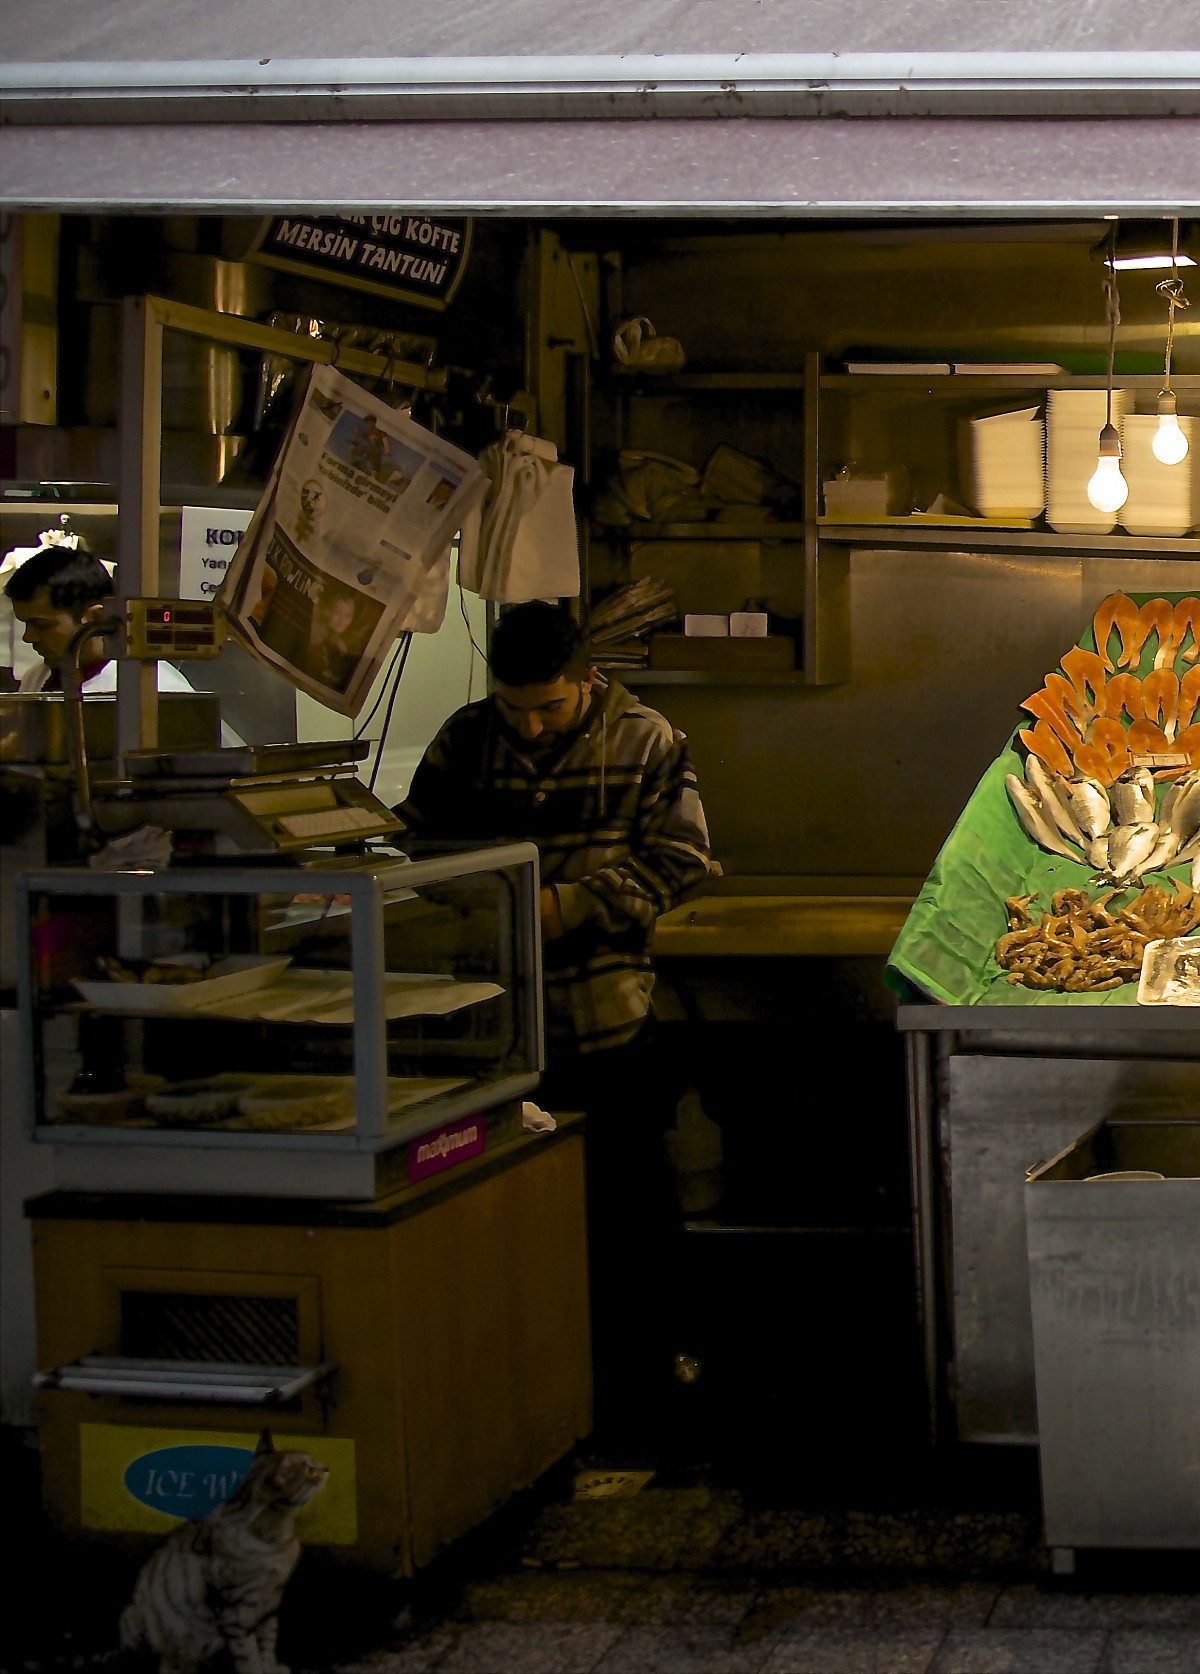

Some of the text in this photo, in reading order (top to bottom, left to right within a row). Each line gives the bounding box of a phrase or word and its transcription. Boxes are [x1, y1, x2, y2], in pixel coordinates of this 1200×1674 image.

[405, 217, 460, 254] KÖFTE
[276, 219, 449, 285] MERSİN TANTUNİ
[321, 452, 355, 479] Forma
[200, 581, 221, 594] Çe
[163, 610, 171, 623] 0
[145, 1469, 245, 1499] ICE W
